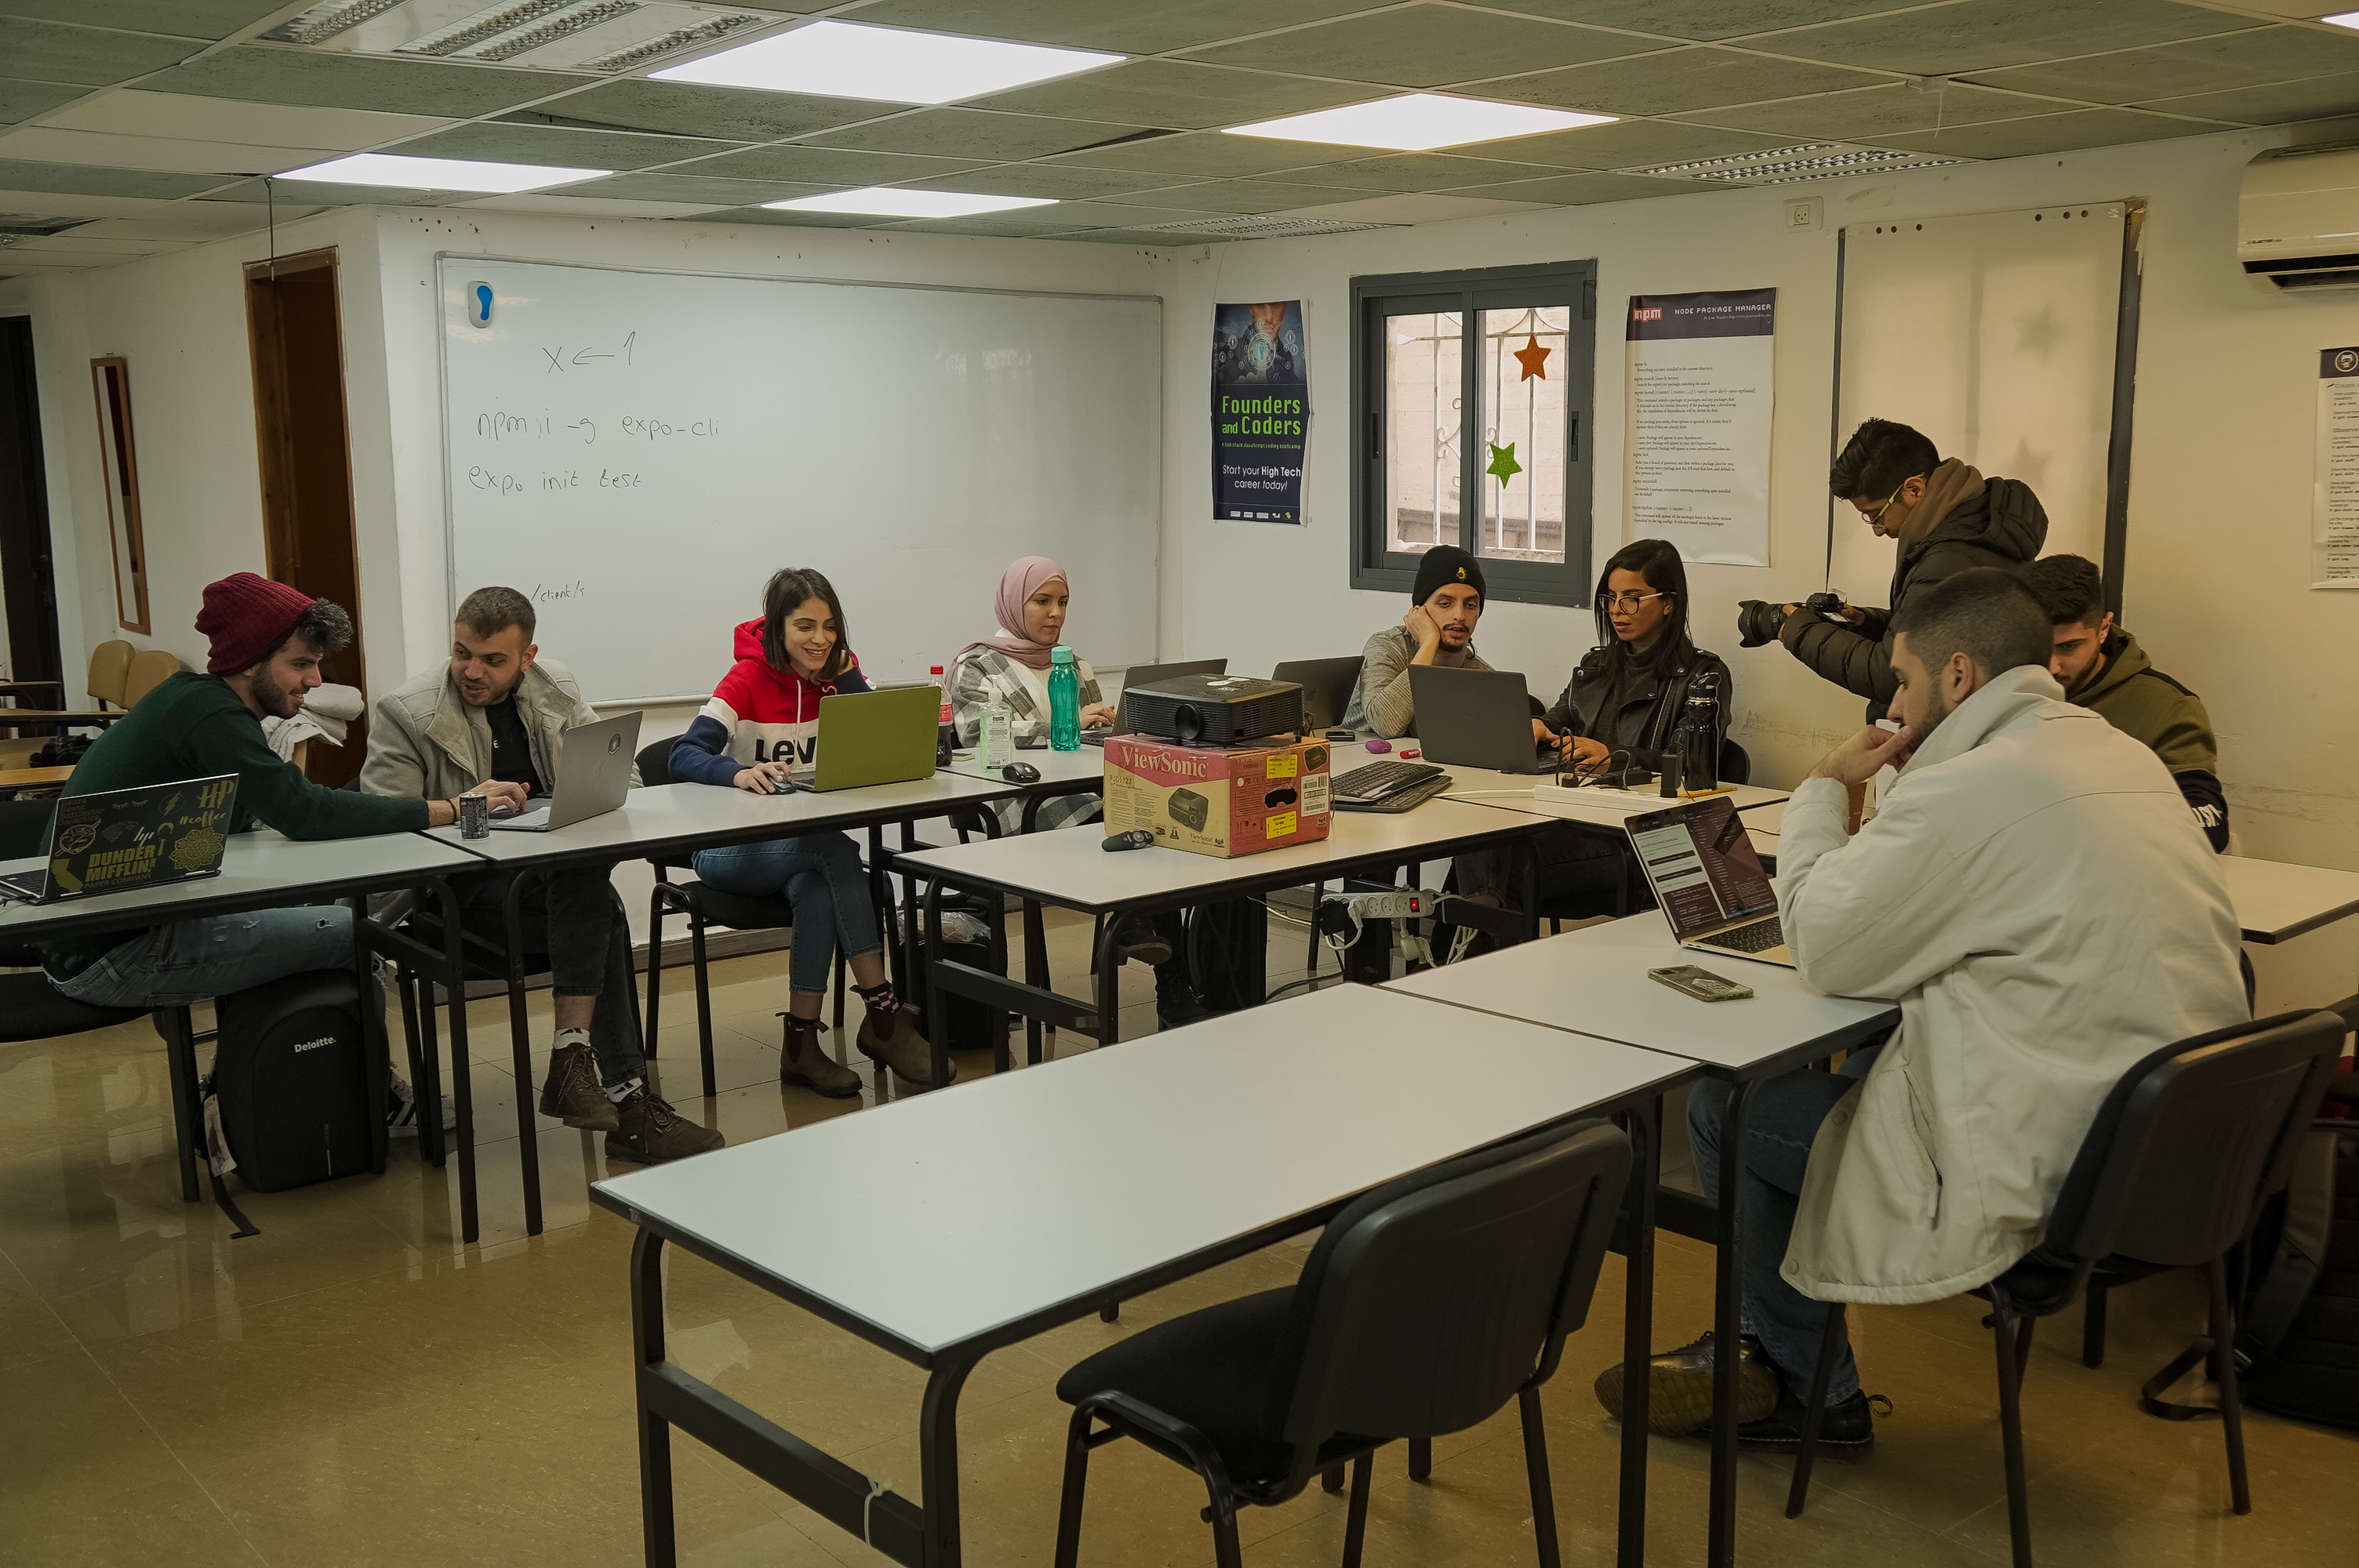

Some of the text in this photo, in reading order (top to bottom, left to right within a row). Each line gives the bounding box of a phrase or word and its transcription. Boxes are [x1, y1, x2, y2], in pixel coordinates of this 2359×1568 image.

[1634, 309, 1660, 320] npm
[1735, 303, 1772, 312] MANAGER
[1222, 395, 1301, 415] Founders
[477, 412, 528, 441] npm
[622, 416, 720, 441] expo-cli
[1222, 416, 1301, 436] and Coders
[468, 466, 642, 496] expo init test
[1222, 464, 1301, 478] Start your High Tech
[1234, 480, 1288, 492] career today!
[1121, 746, 1207, 778] ViewSonic
[197, 780, 234, 809] HP
[89, 844, 156, 867] DUNDER
[84, 873, 152, 890] PAPER COMPANY
